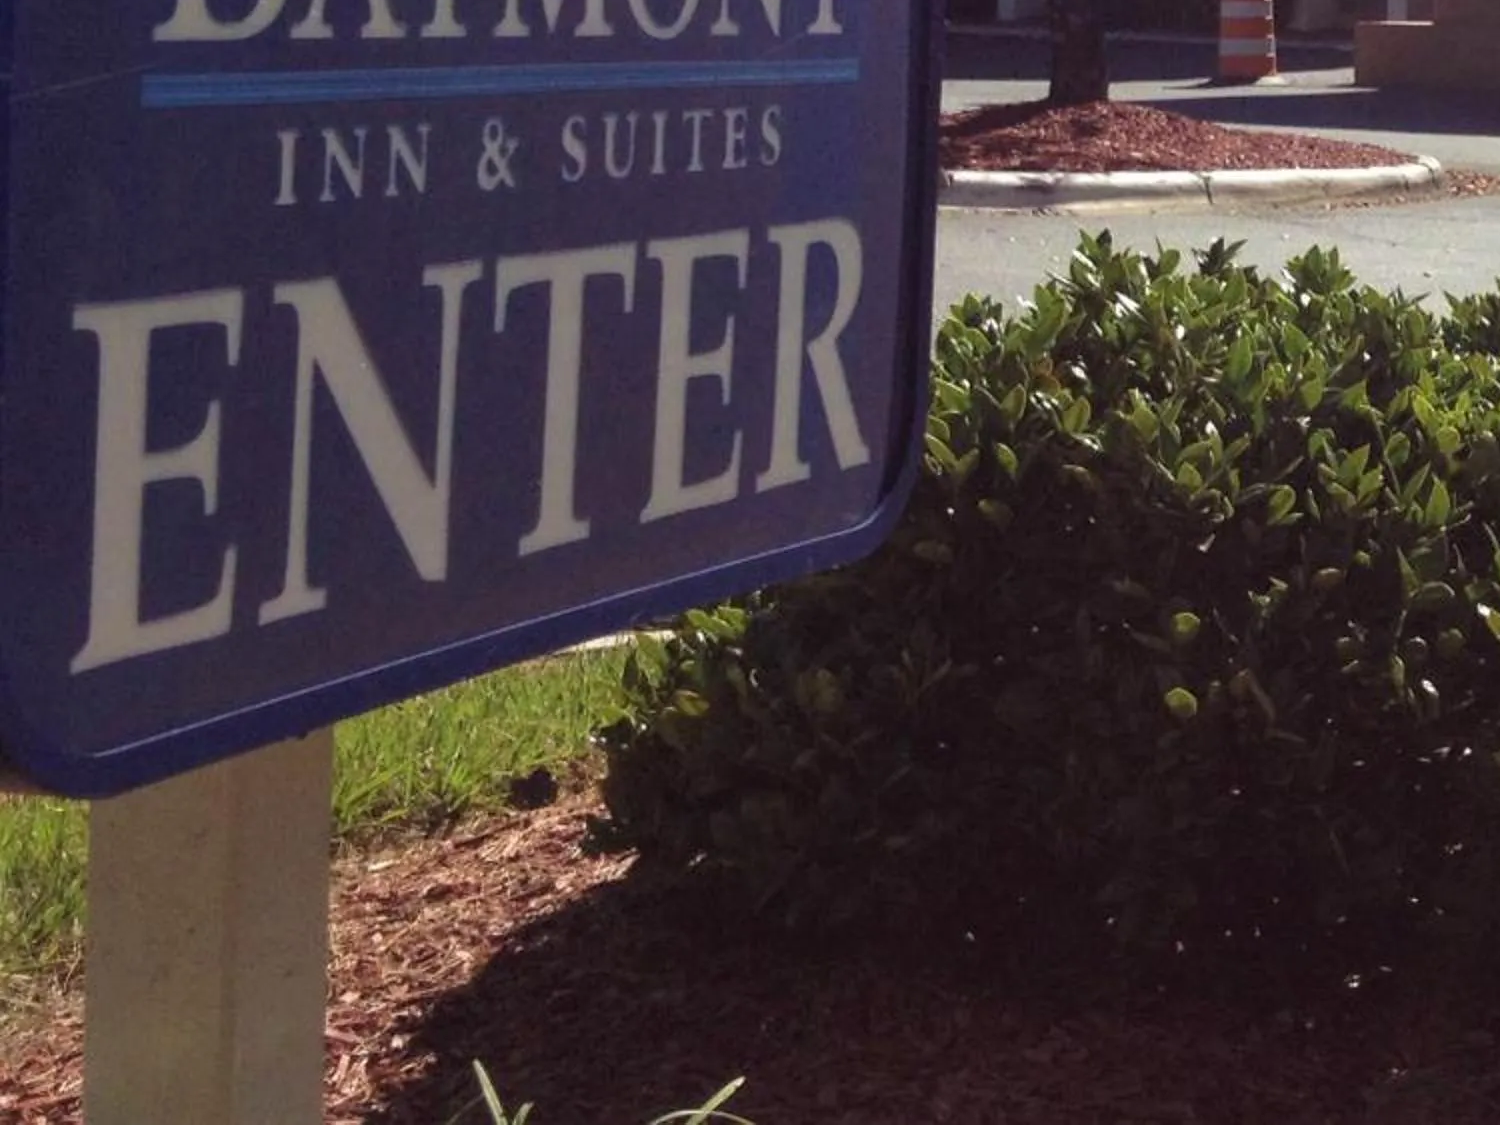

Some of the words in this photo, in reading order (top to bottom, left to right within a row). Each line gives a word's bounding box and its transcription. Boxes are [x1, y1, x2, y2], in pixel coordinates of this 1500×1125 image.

[276, 125, 432, 206] INN
[477, 115, 521, 190] &
[561, 105, 784, 183] SUITES
[70, 217, 870, 675] ENTER
